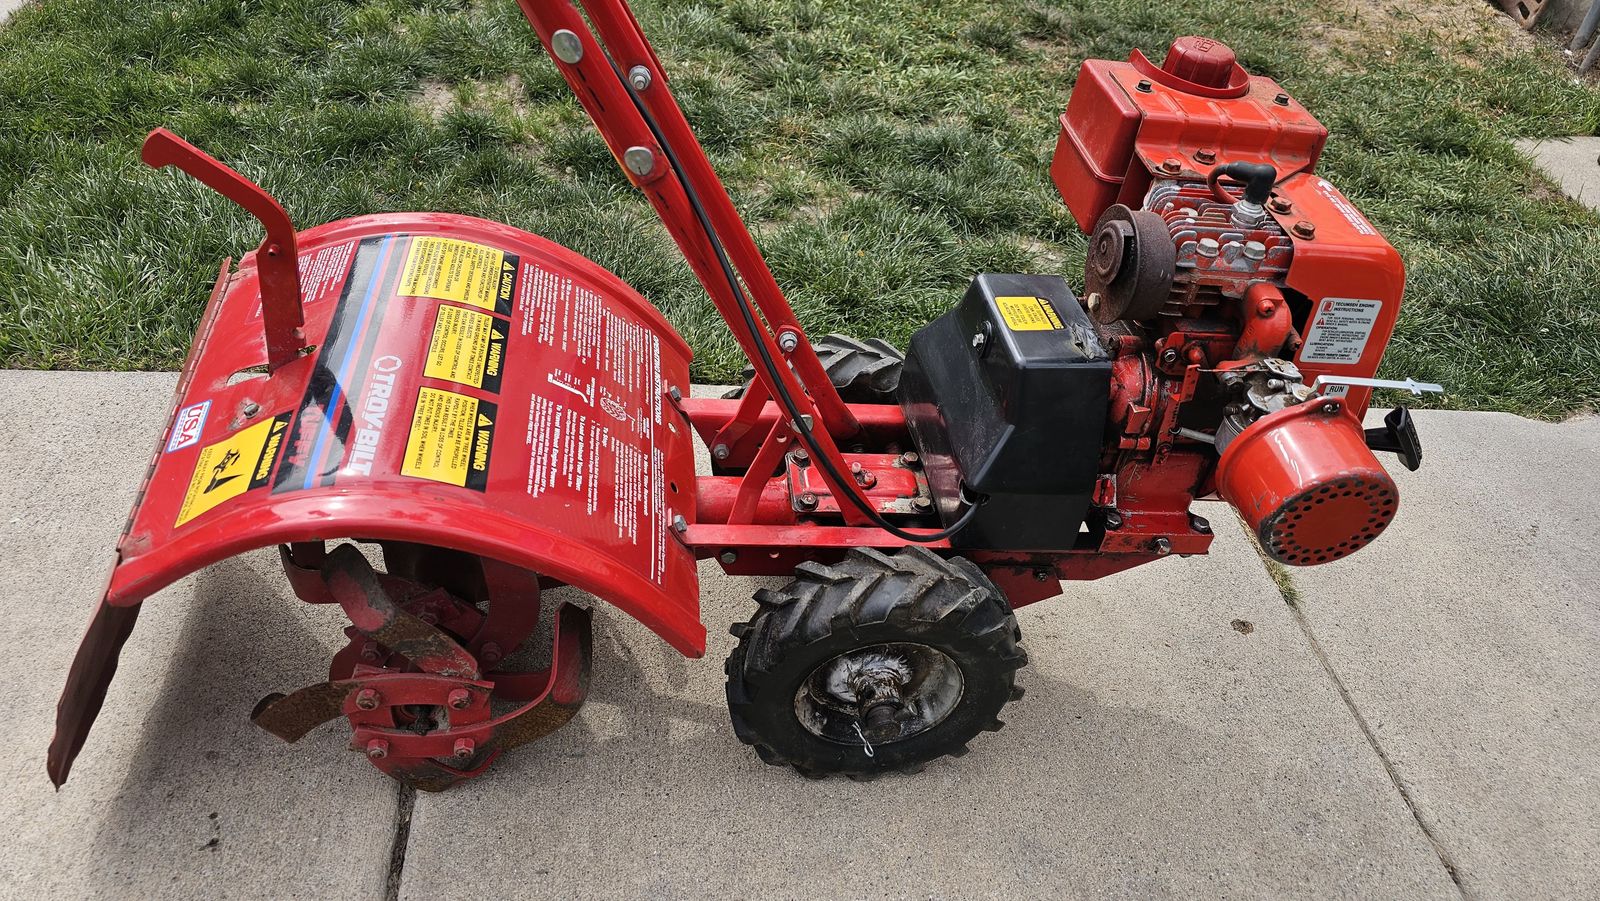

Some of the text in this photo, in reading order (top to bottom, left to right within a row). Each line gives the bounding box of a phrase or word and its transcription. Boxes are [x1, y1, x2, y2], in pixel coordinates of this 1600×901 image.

[499, 272, 512, 300] CAUTION
[1043, 304, 1064, 329] WARNING
[486, 342, 501, 376] WARNING
[654, 372, 662, 425] INSTRUCTIONS
[176, 404, 204, 448] USA
[349, 373, 395, 477] TROY-BILT
[553, 428, 561, 448] Without
[256, 433, 282, 481] WARNING
[472, 430, 489, 471] WARNING
[551, 448, 559, 467] Engine
